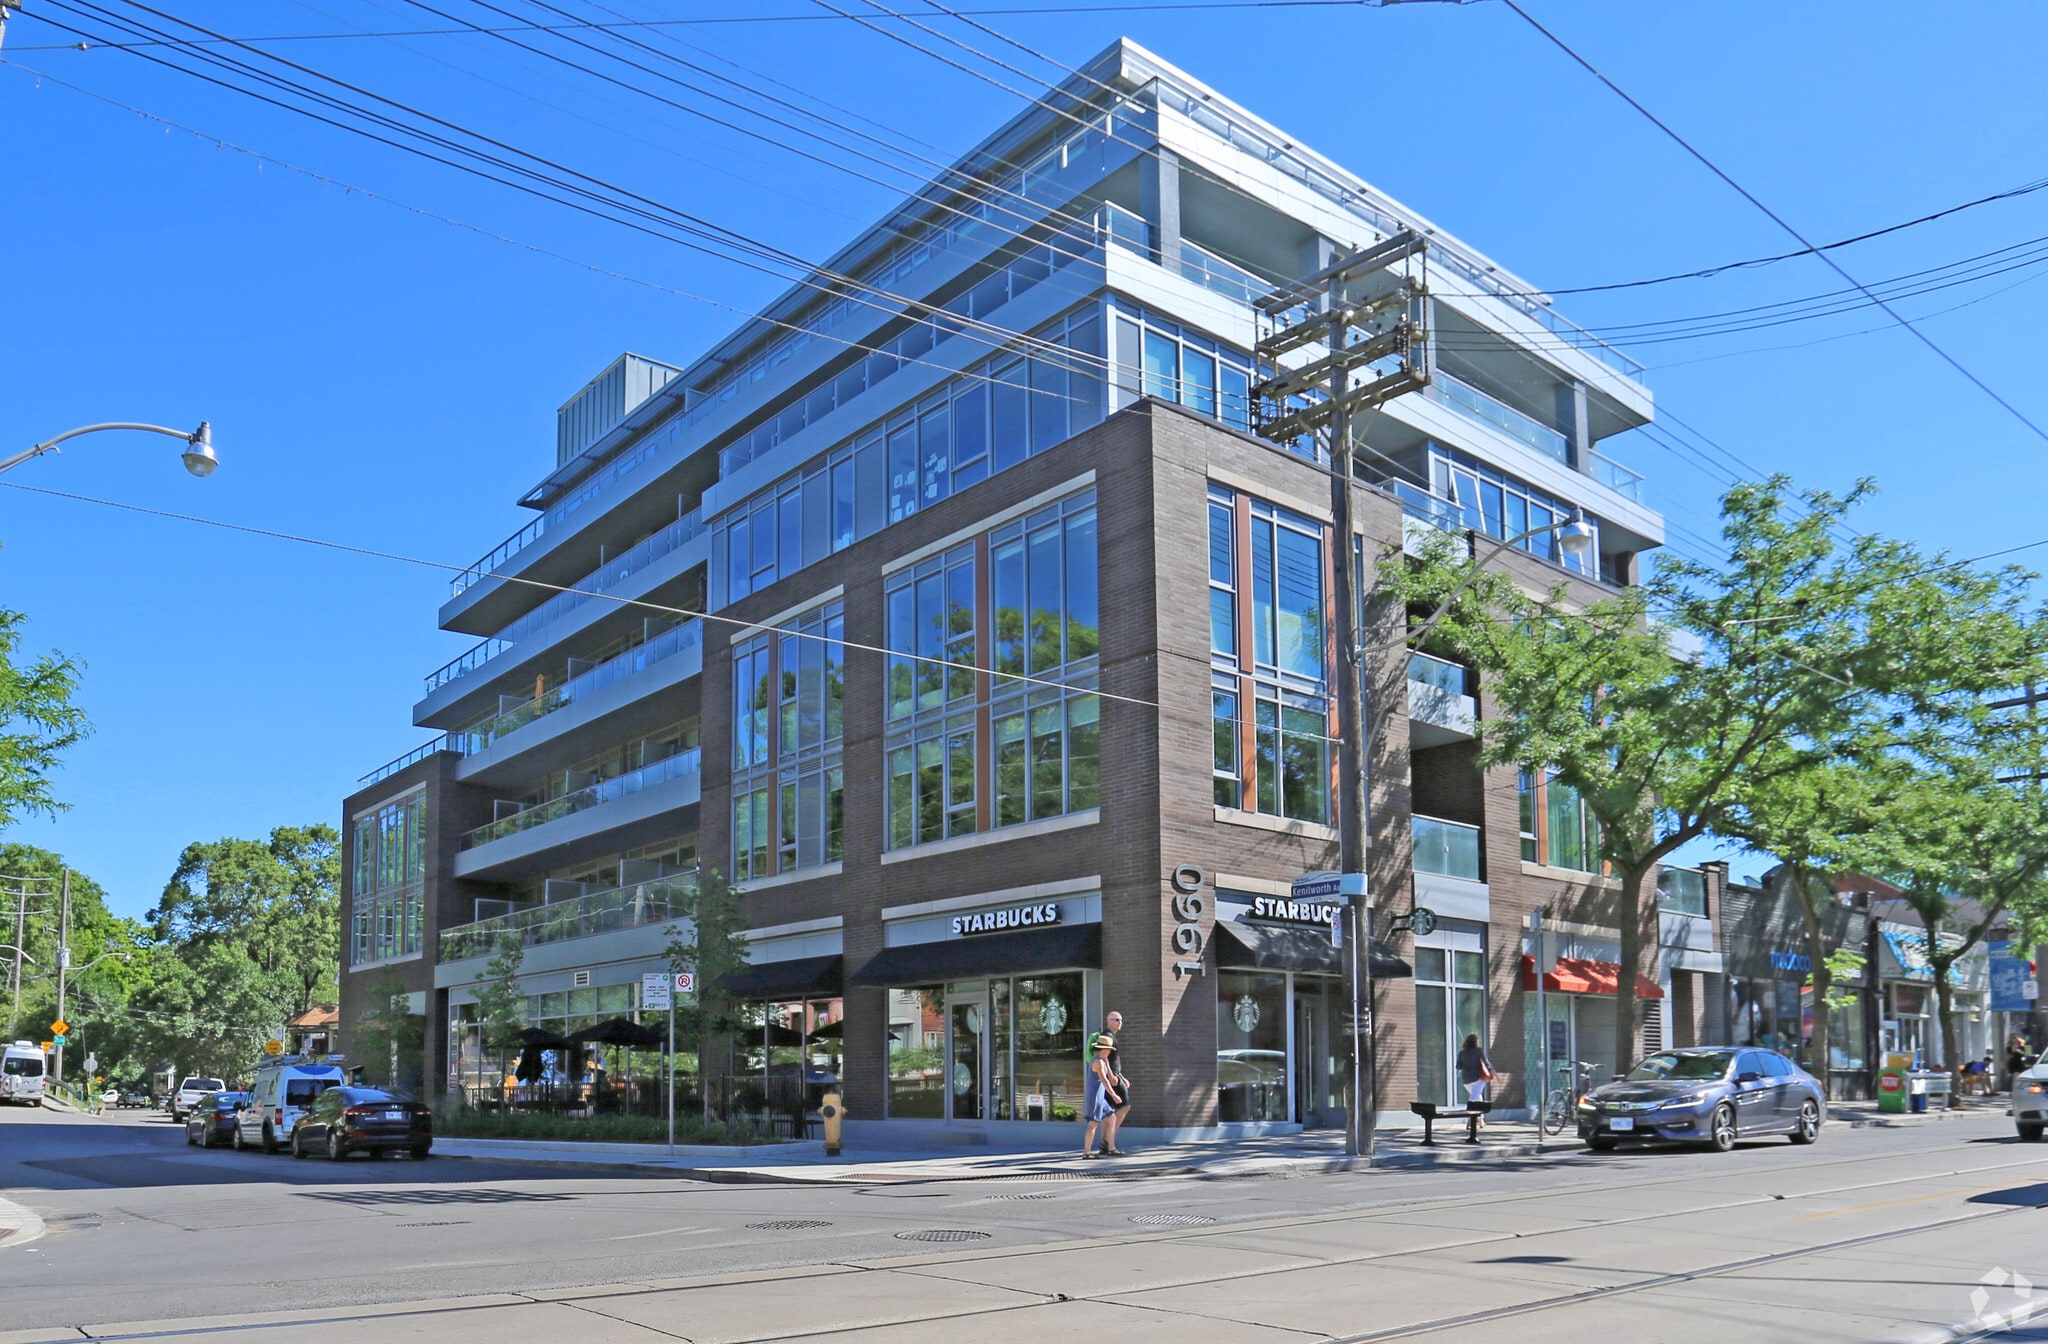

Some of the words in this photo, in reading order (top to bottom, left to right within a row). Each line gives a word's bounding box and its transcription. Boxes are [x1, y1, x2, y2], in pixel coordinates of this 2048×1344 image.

[1292, 883, 1332, 897] Kenilworth
[951, 903, 1057, 934] STARBUCKS
[1175, 863, 1205, 976] 1960
[1255, 897, 1341, 924] STARBUC
